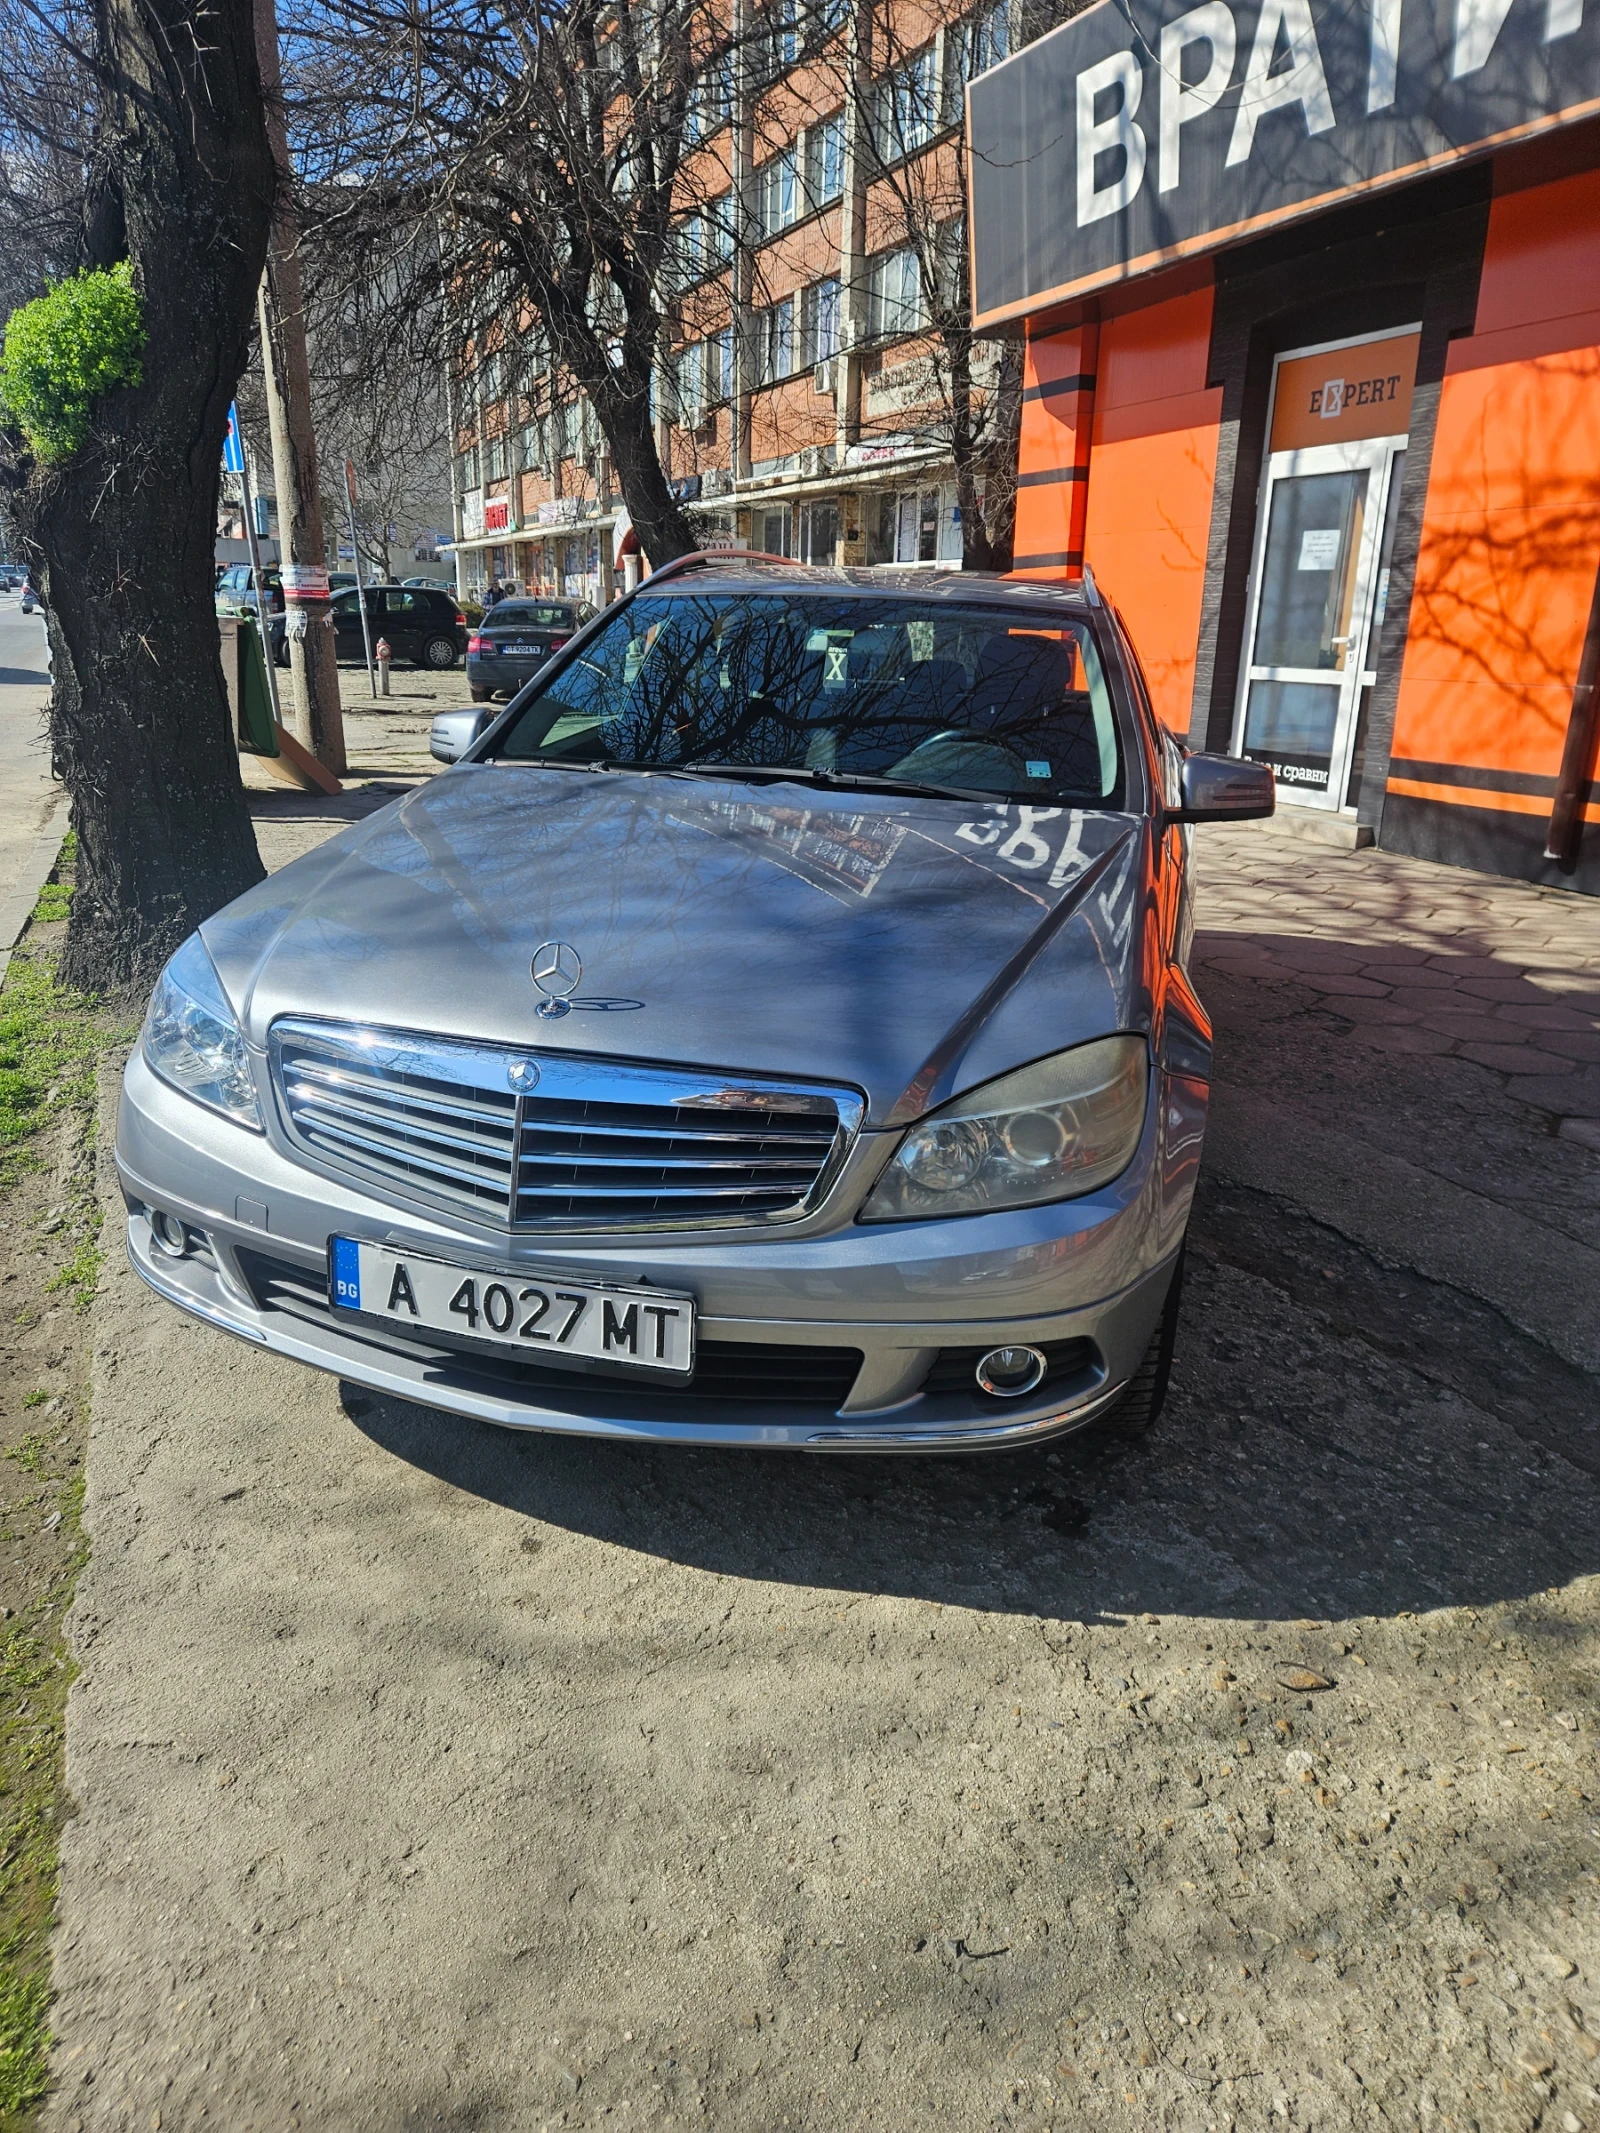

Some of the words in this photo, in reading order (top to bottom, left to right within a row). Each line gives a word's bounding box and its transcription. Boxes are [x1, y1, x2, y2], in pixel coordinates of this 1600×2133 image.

[1309, 375, 1401, 419] EXPERT
[826, 653, 846, 680] X
[1283, 765, 1328, 783] сравни
[337, 1279, 359, 1299] BG
[386, 1262, 418, 1317] A
[448, 1276, 588, 1344] 4027
[601, 1299, 680, 1359] MT
